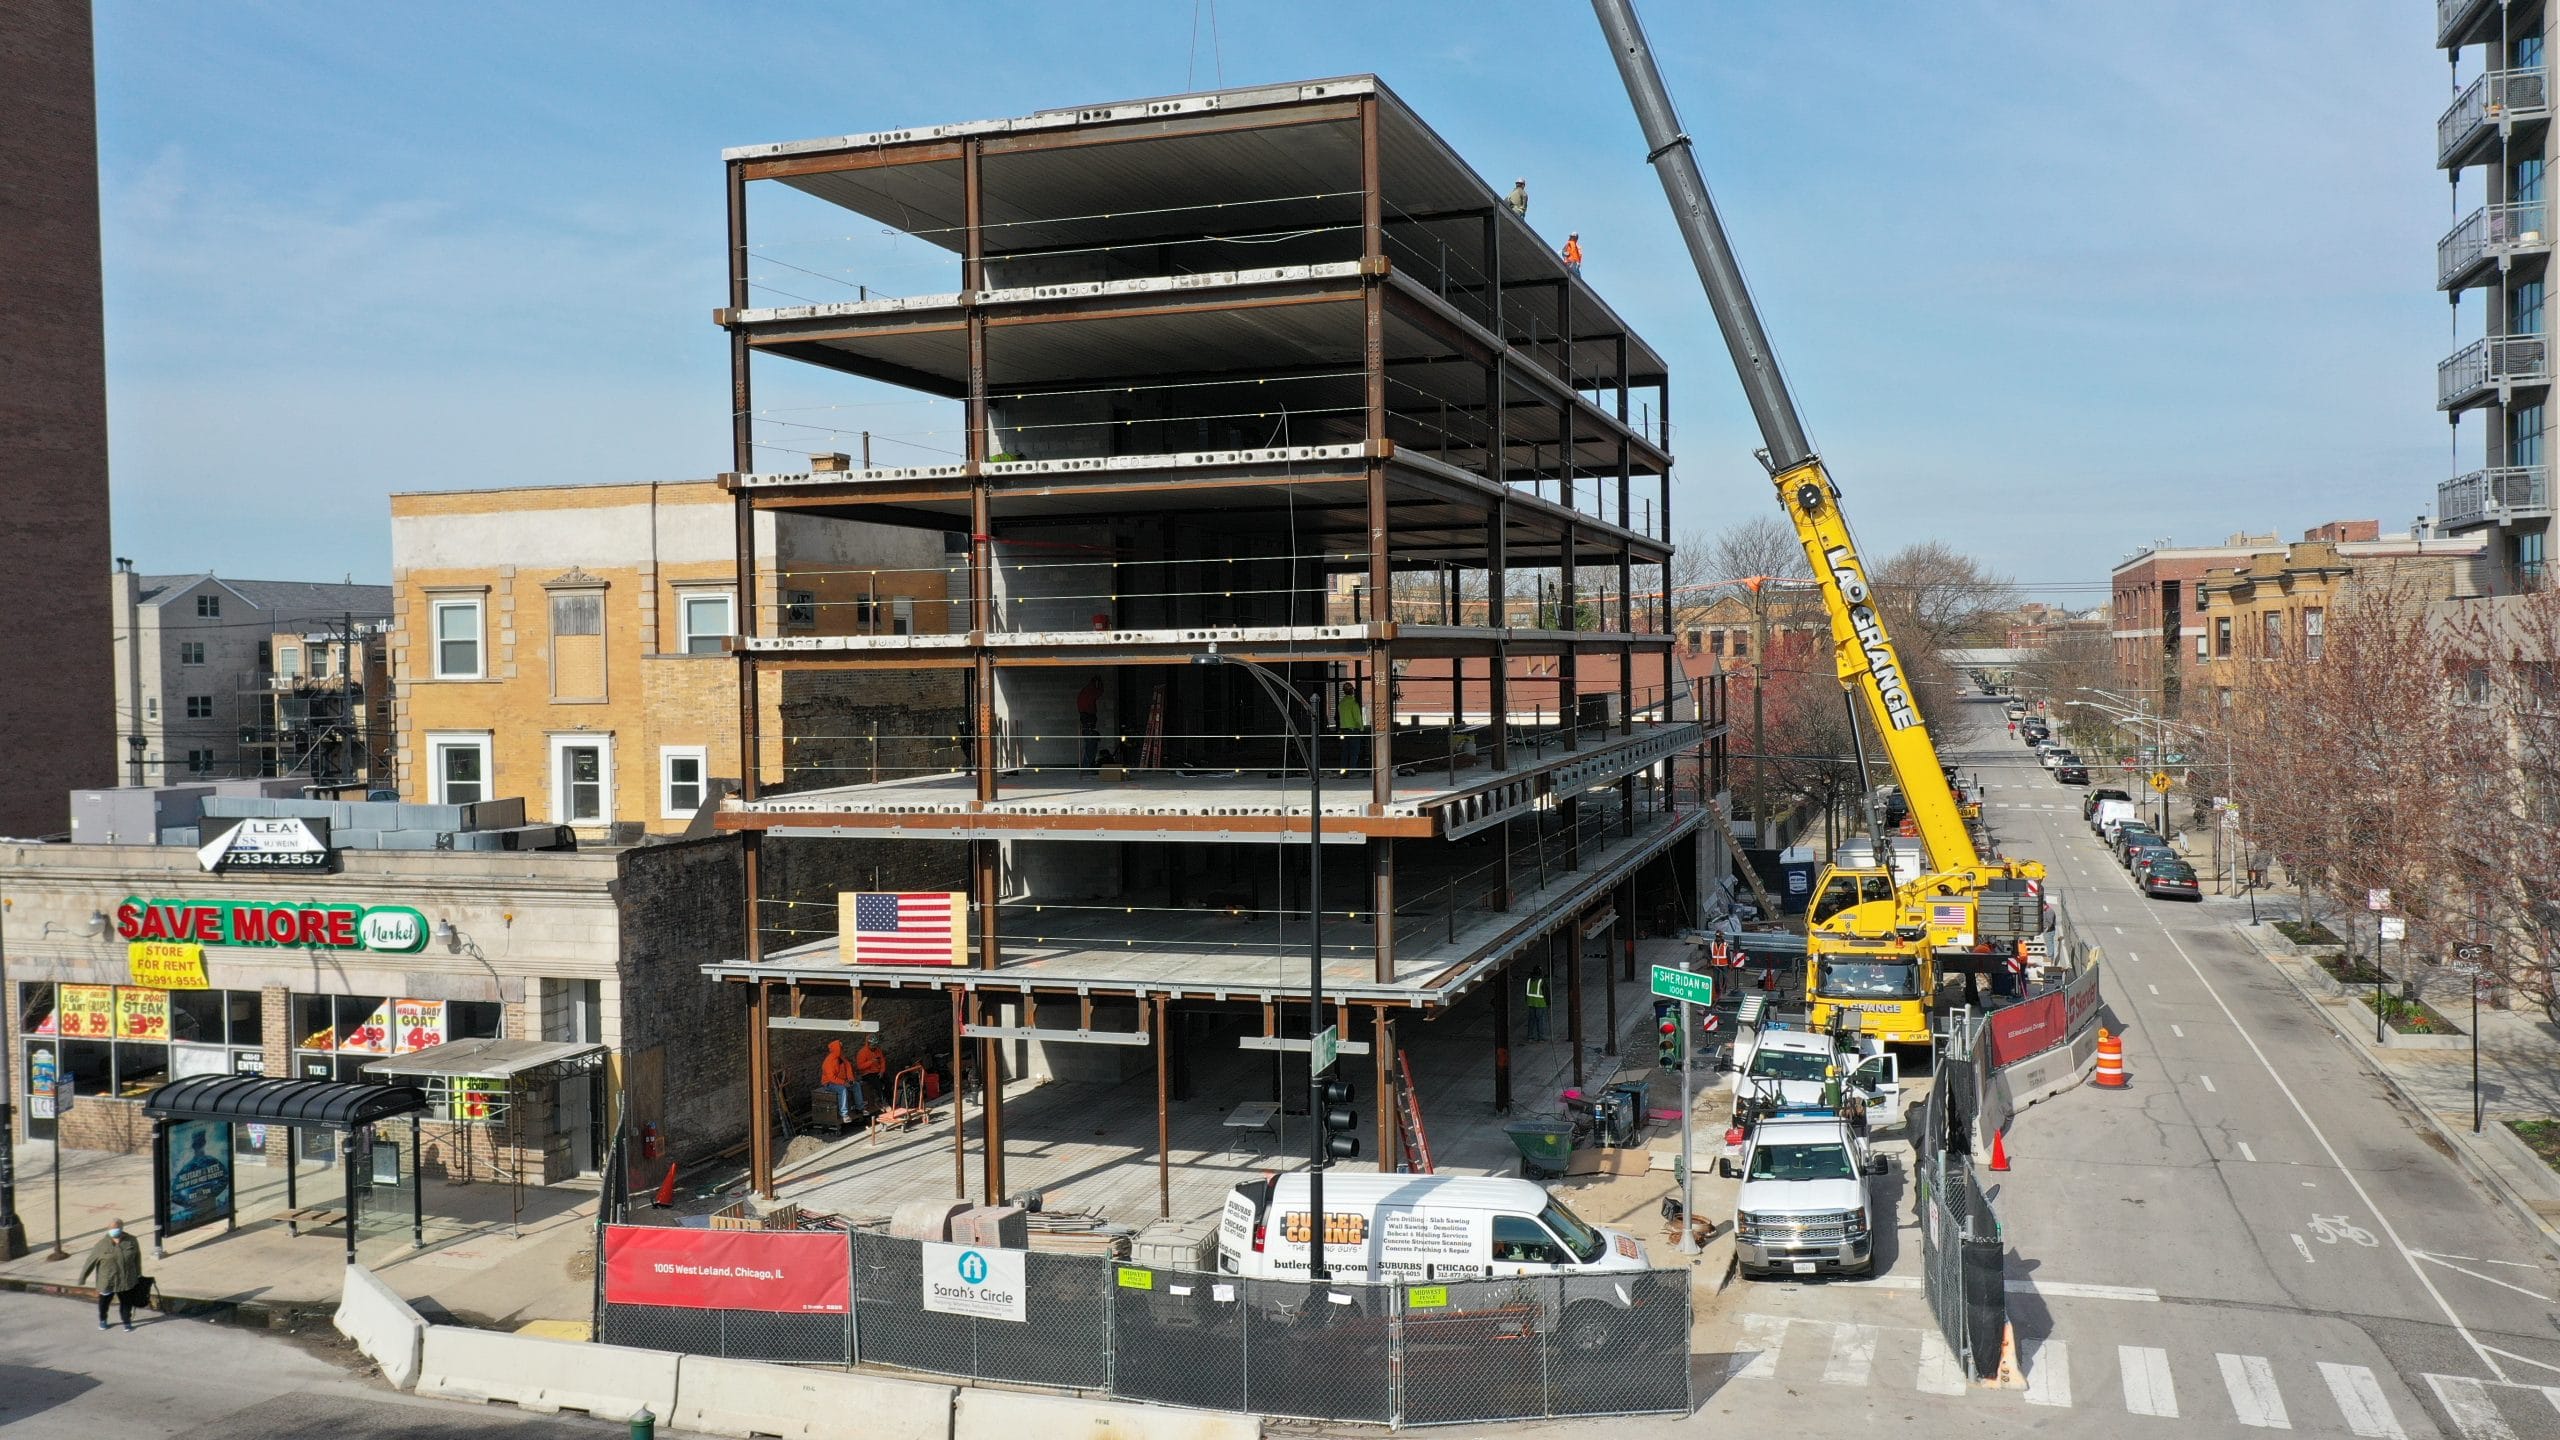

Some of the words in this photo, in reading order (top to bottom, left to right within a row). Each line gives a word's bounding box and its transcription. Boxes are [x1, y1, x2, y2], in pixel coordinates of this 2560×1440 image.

[1851, 605, 1918, 731] GRANGE
[232, 908, 357, 945] MORE
[363, 918, 414, 942] Market
[146, 945, 183, 957] STORE
[137, 960, 160, 970] FOR
[163, 960, 195, 972] RENT
[1660, 970, 1700, 990] SHERIDAN
[1701, 981, 1710, 990] RD
[1669, 985, 1684, 996] 1000
[123, 1001, 165, 1015] STEAK
[421, 1008, 442, 1017] BABY
[62, 1013, 80, 1033] 88
[401, 1015, 436, 1028] GOAT
[238, 1061, 264, 1071] ENTER
[1224, 1218, 1247, 1234] CHICAGO
[1285, 1210, 1365, 1230] BULER
[1401, 1216, 1425, 1224] Drilling
[1286, 1227, 1362, 1245] COING
[654, 1263, 675, 1274] 1005
[675, 1264, 698, 1275] West
[698, 1266, 734, 1278] Leland,
[734, 1267, 774, 1281] Chicago,
[775, 1271, 784, 1279] IL
[1274, 1259, 1369, 1273] butlercing.com
[1378, 1262, 1423, 1271] SUBURBS
[1436, 1263, 1479, 1273] CHICAGO
[934, 1283, 975, 1299] Sarah's
[980, 1289, 1014, 1304] Circle
